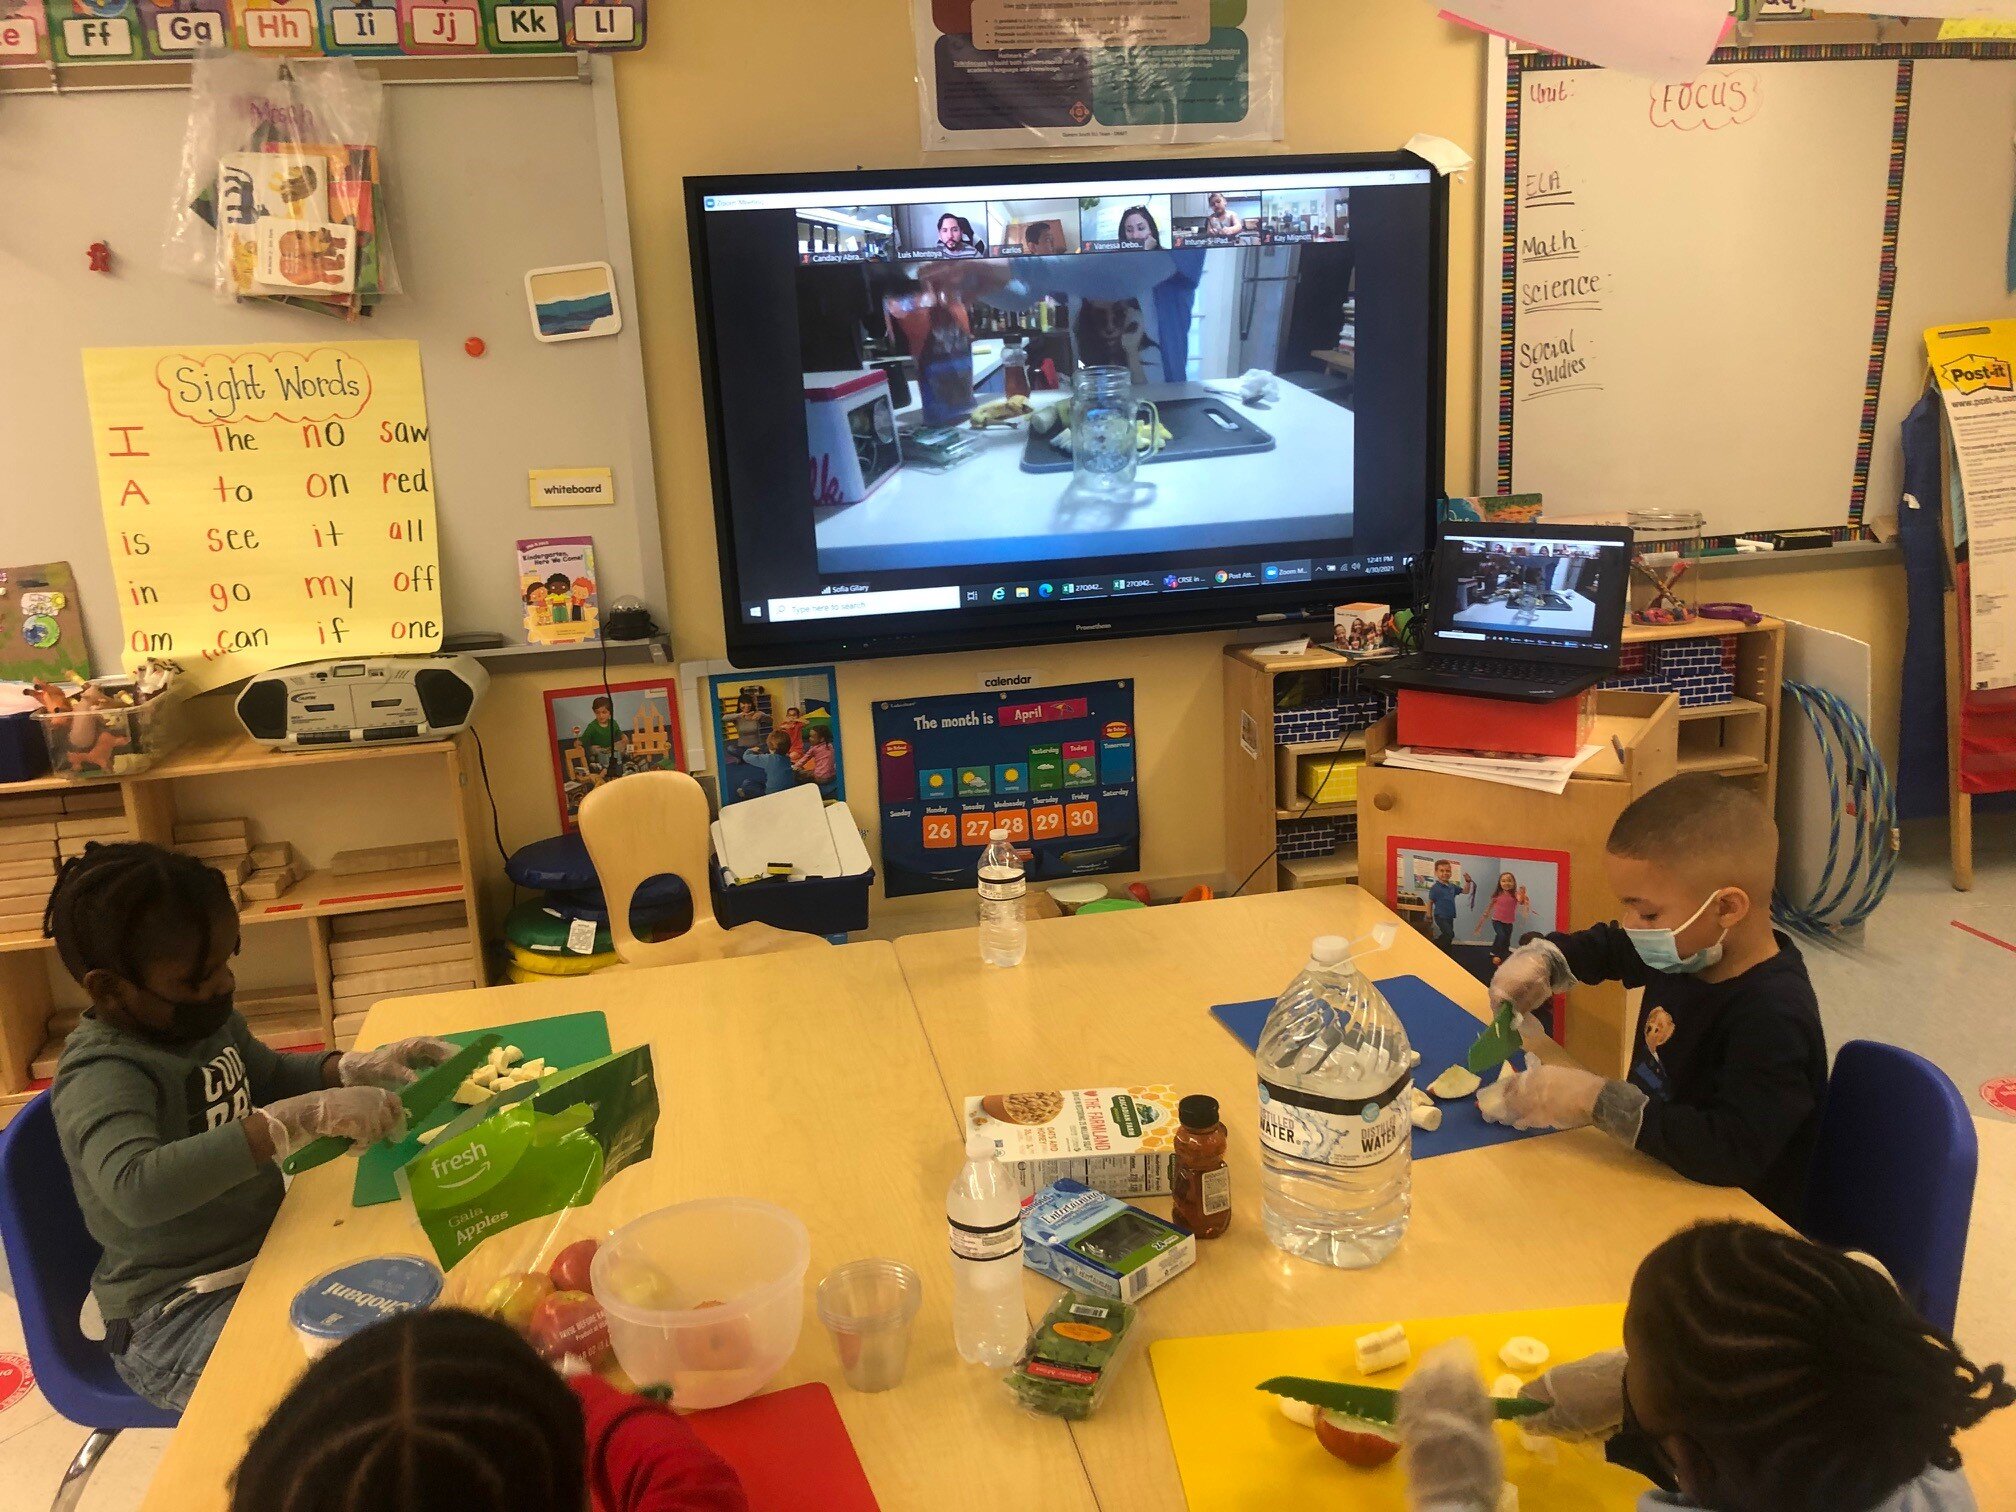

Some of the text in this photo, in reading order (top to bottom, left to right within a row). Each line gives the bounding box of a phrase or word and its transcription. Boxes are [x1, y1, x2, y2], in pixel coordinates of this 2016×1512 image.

[256, 14, 298, 38] Hh
[356, 12, 375, 36] Ii
[432, 13, 456, 42] Jj
[510, 10, 546, 34] Kk
[595, 9, 615, 34] Ll
[82, 22, 111, 47] Ff
[1663, 82, 1747, 113] FOCUS
[898, 251, 912, 259] Luis
[1093, 242, 1121, 250] Vanessa
[1531, 356, 1587, 387] Studies
[1951, 363, 2006, 382] Post-it
[176, 359, 360, 418] Sight Words
[108, 421, 429, 456] I The no saw
[121, 468, 429, 506] A to on red
[544, 484, 601, 496] whiteboard
[121, 519, 423, 555] is see it all
[563, 554, 584, 562] Come!
[128, 565, 436, 612] in go my off
[792, 606, 809, 615] Type
[831, 603, 839, 611] to
[841, 602, 866, 610] search
[131, 617, 439, 652] am can if one
[985, 674, 1032, 688] calendar
[914, 711, 994, 731] The month is
[1015, 705, 1042, 723] April
[1031, 746, 1060, 756] Yesterday
[1070, 744, 1088, 754] Today
[1103, 741, 1130, 750] Tomorrow
[1032, 796, 1059, 804] Thursday
[1072, 792, 1090, 801] Friday
[1103, 788, 1129, 797] Saturday
[926, 806, 948, 814] Monday
[962, 802, 986, 812] Tuesday
[994, 799, 1026, 808] Wednesday
[890, 810, 912, 818] Sunday
[1036, 813, 1059, 831] 29
[1071, 809, 1094, 826] 30
[928, 823, 951, 839] 26
[966, 820, 989, 836] 27
[1000, 818, 1024, 833] 28
[1085, 1097, 1111, 1150] THE FARMLAND
[1260, 1119, 1295, 1144] WATER
[1361, 1115, 1397, 1140] DISTILLE
[1038, 1127, 1048, 1144] HONEY
[1047, 1126, 1058, 1152] OATS AND
[1361, 1125, 1396, 1153] WATER
[431, 1141, 488, 1179] fresh
[1040, 1190, 1106, 1224] Entertaining
[448, 1206, 483, 1229] Gala
[456, 1209, 509, 1246] Apples
